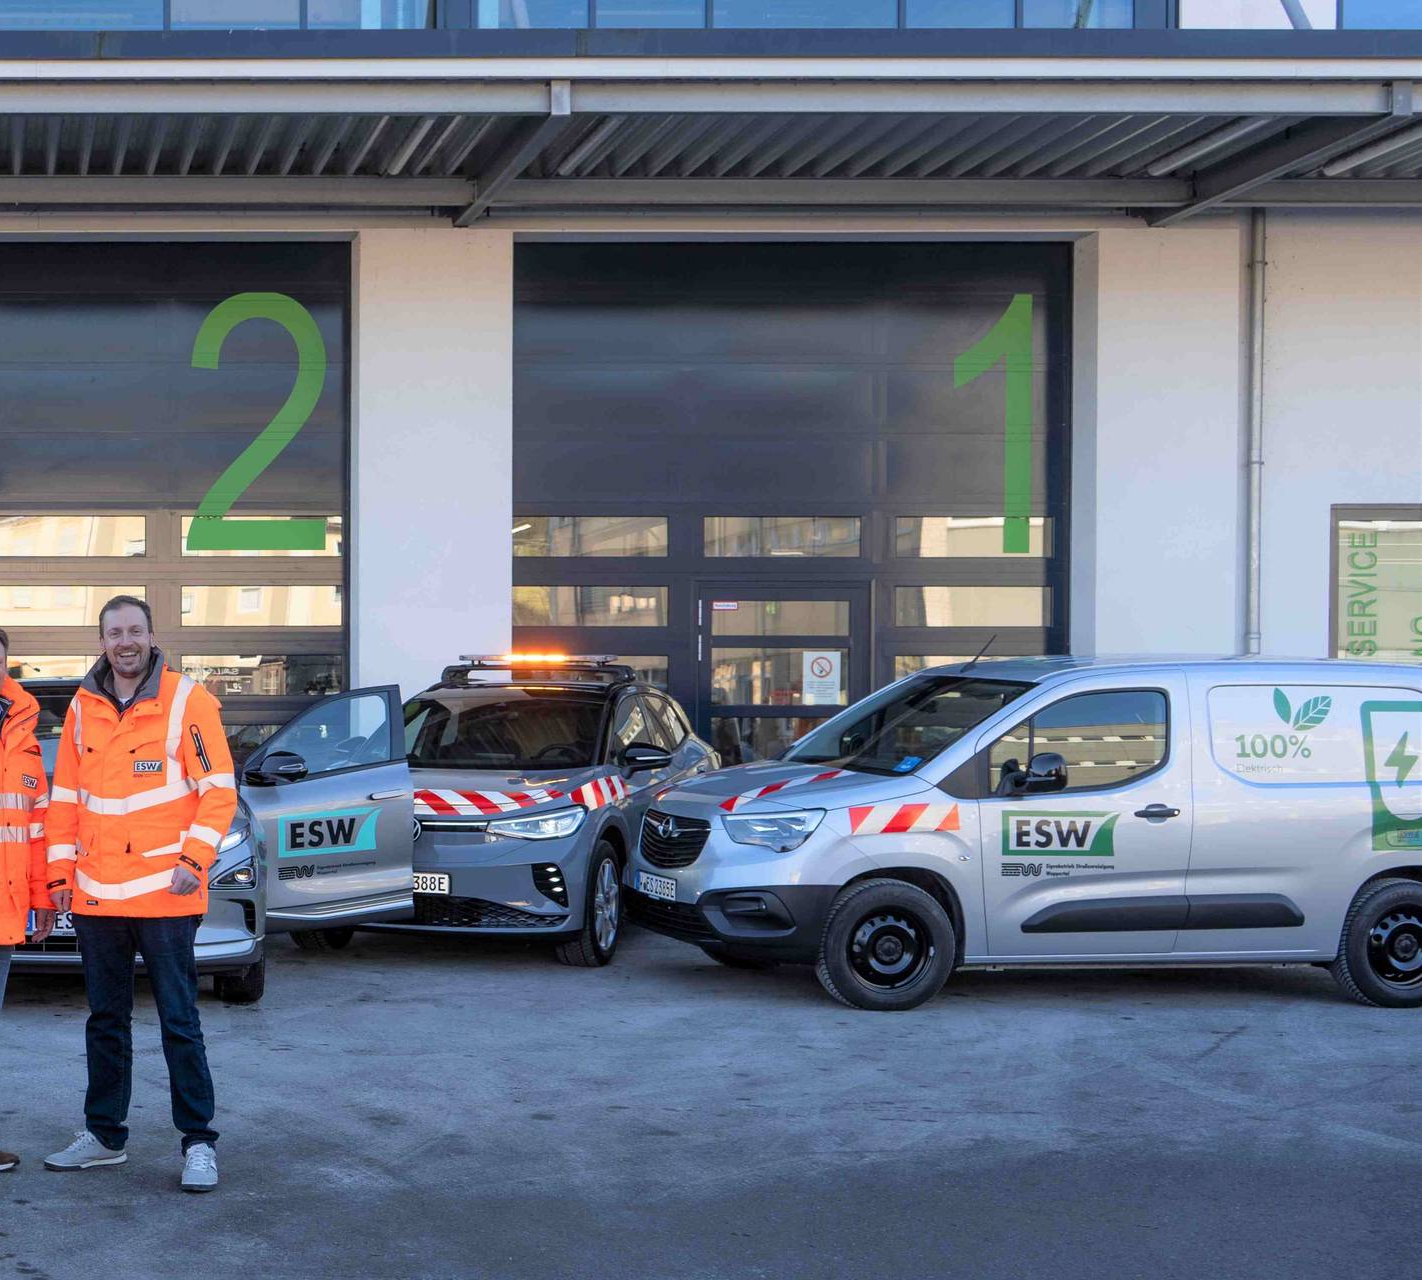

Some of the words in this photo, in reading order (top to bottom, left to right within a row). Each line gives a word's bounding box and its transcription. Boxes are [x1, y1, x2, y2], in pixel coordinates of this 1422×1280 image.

[186, 292, 327, 551] 2
[954, 293, 1033, 553] 1
[1347, 531, 1378, 657] SERVICE
[1235, 734, 1312, 758] 100%
[136, 762, 157, 771] ESW
[289, 817, 356, 849] ESW
[1015, 819, 1092, 849] ESW
[413, 875, 446, 892] 388E
